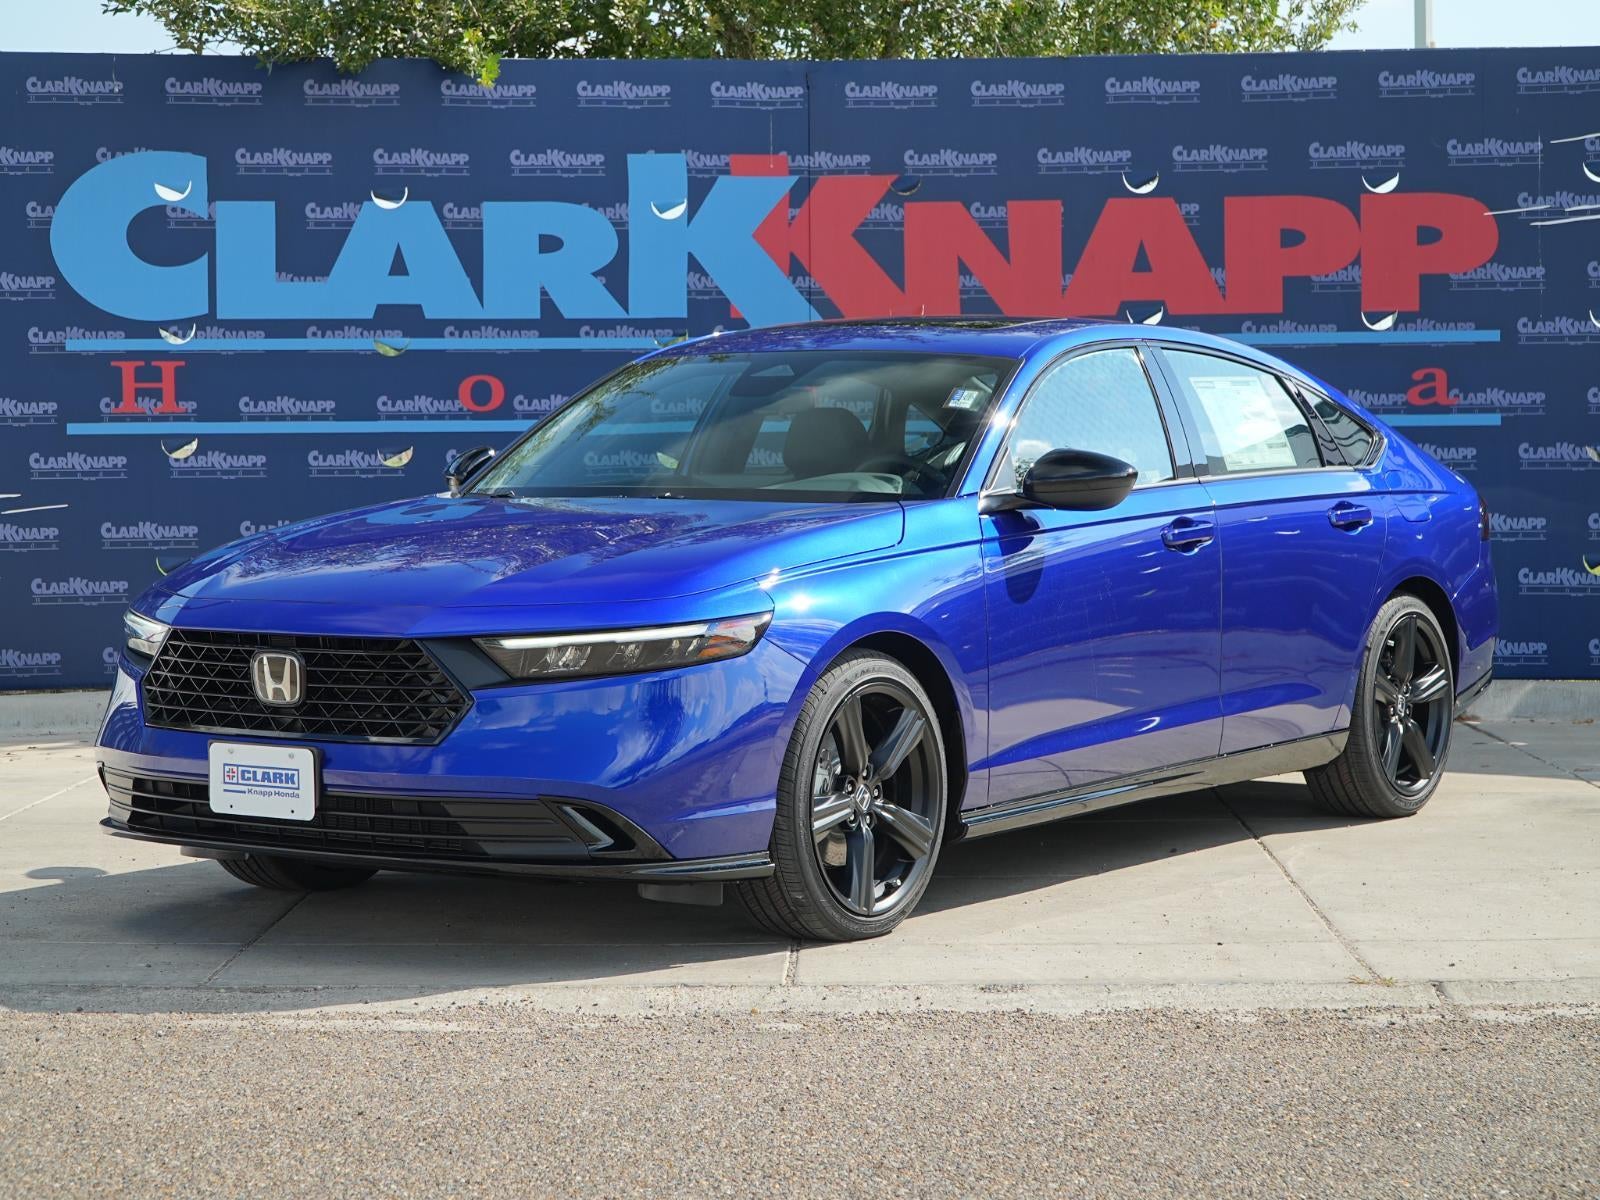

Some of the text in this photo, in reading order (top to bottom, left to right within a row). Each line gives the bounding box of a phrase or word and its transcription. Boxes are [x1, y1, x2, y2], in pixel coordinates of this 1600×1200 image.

[240, 769, 296, 785] CLARK
[247, 787, 300, 799] Knapp Honda
